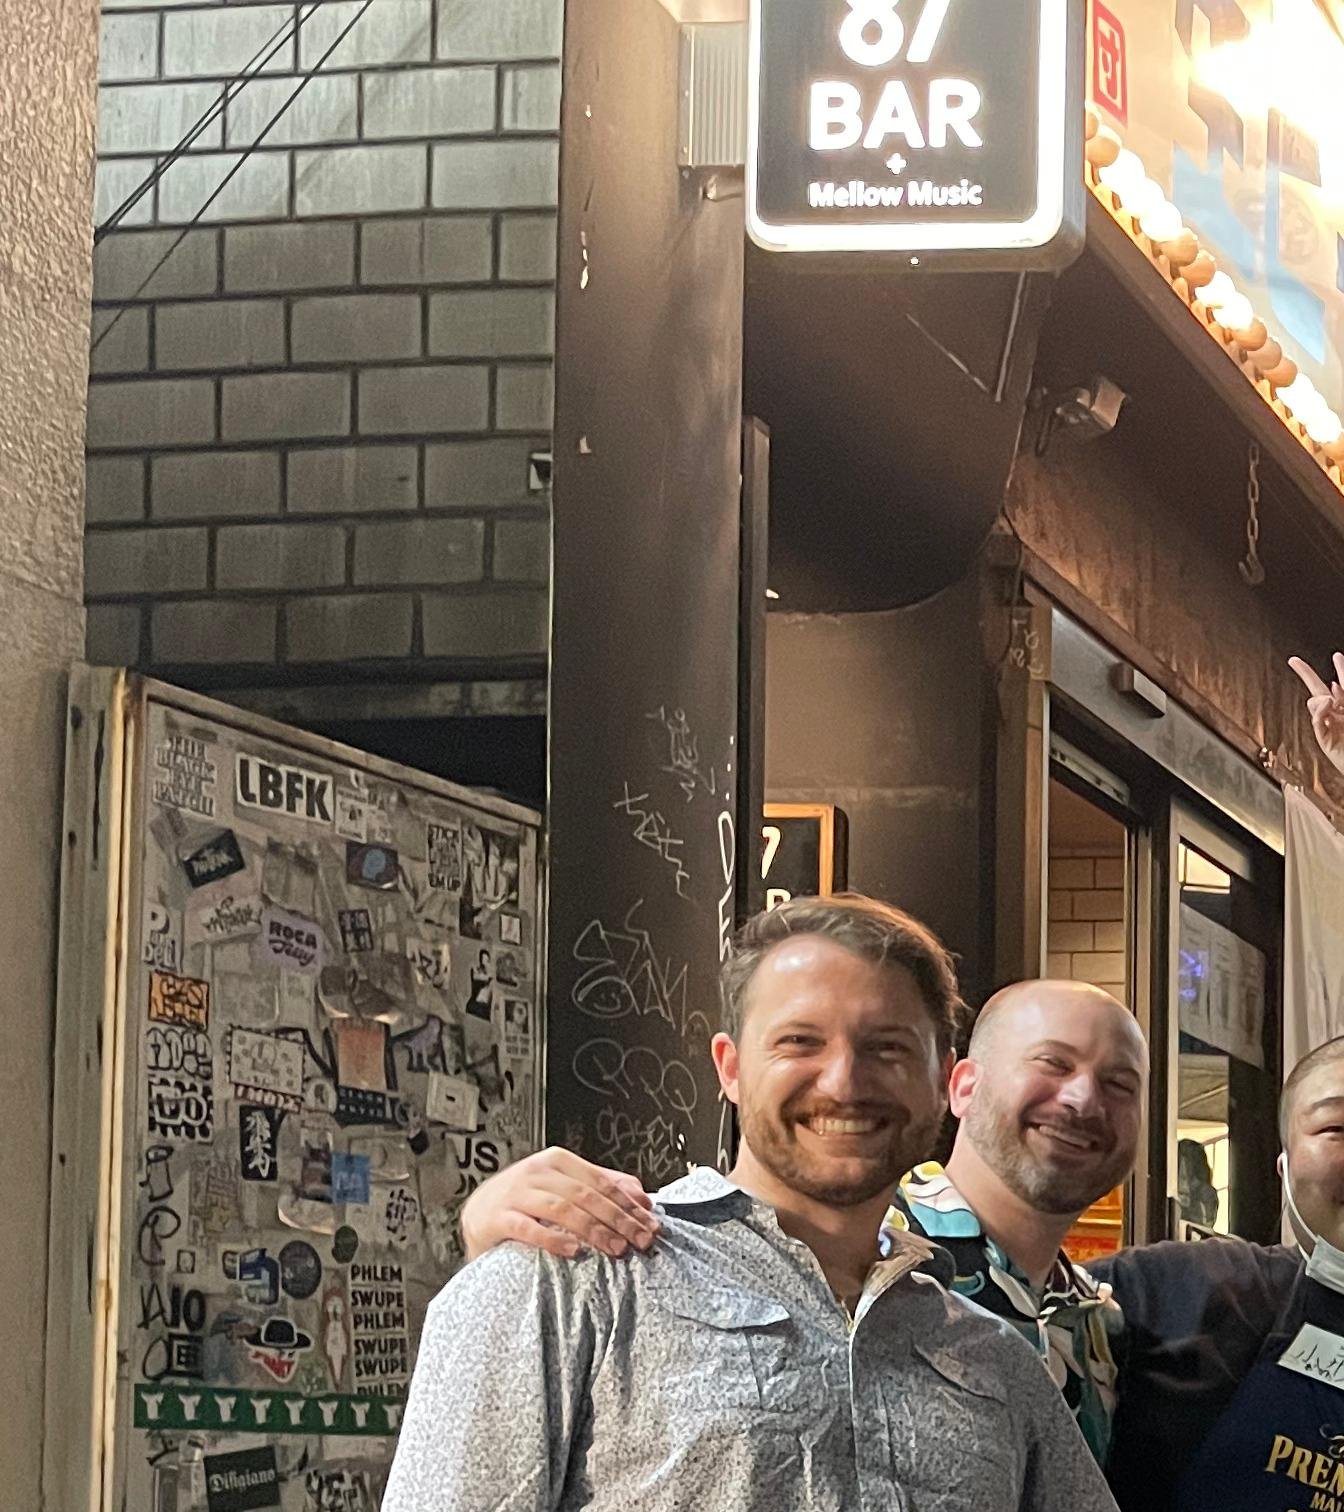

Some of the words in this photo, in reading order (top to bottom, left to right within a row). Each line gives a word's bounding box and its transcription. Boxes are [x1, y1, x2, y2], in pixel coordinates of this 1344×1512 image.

[809, 78, 984, 150] BAR
[809, 181, 903, 207] Mellow
[908, 179, 983, 207] Music
[239, 758, 332, 822] LBFK
[351, 1265, 402, 1283] PHLEM
[353, 1312, 405, 1330] PHLEM
